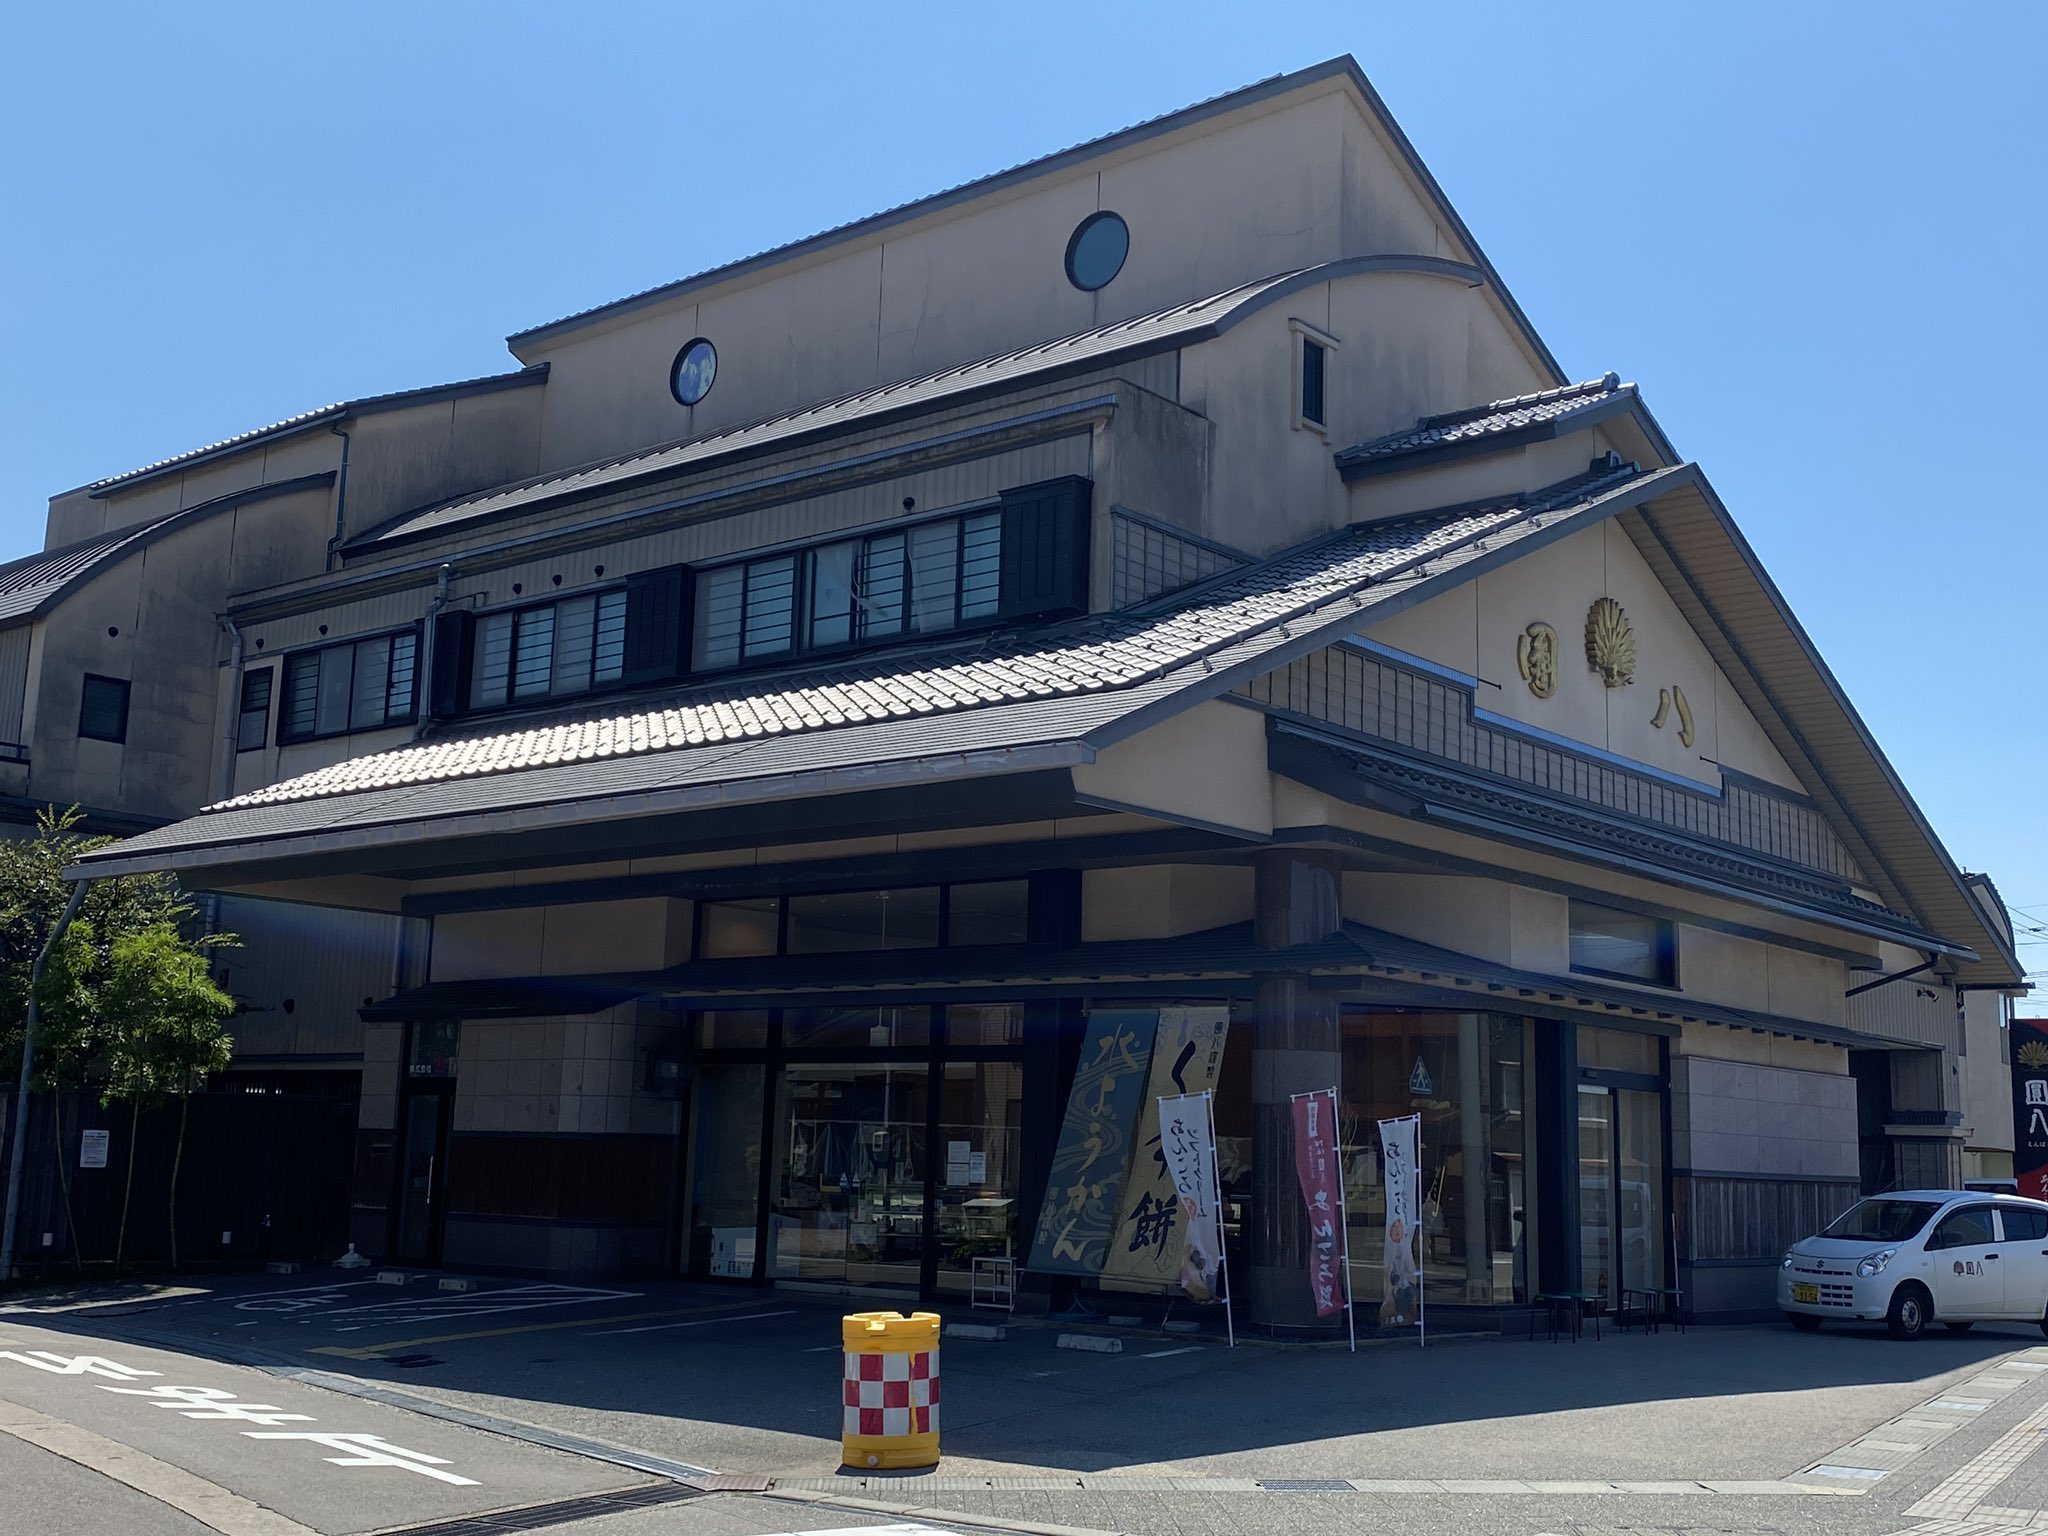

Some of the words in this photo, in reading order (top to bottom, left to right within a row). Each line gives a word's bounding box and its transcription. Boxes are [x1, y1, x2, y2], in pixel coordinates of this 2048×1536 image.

[1052, 1022, 1140, 1263] 水ようかん
